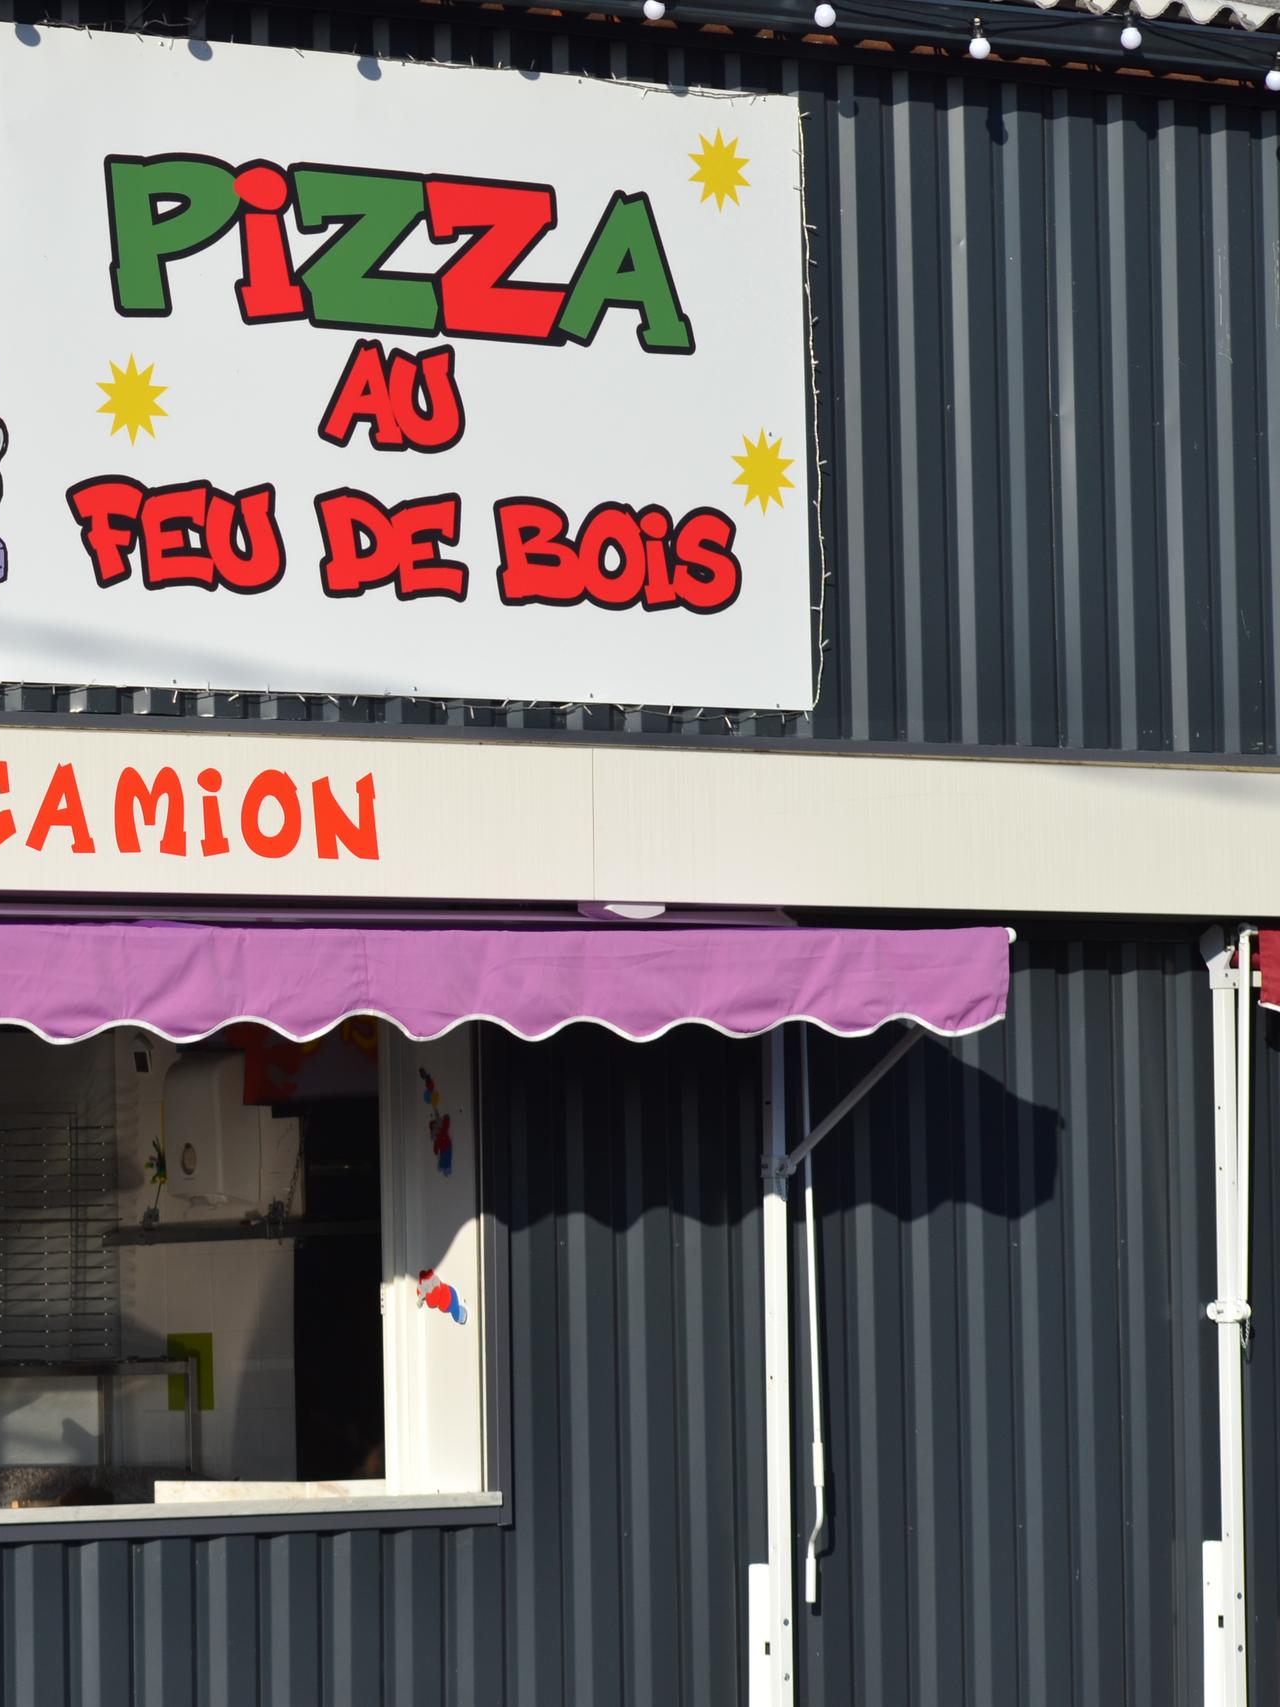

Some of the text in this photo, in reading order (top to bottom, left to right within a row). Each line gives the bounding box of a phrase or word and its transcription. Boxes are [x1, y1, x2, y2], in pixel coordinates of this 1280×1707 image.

[318, 338, 465, 453] AU
[65, 475, 285, 594] FEU
[314, 486, 469, 601] DE
